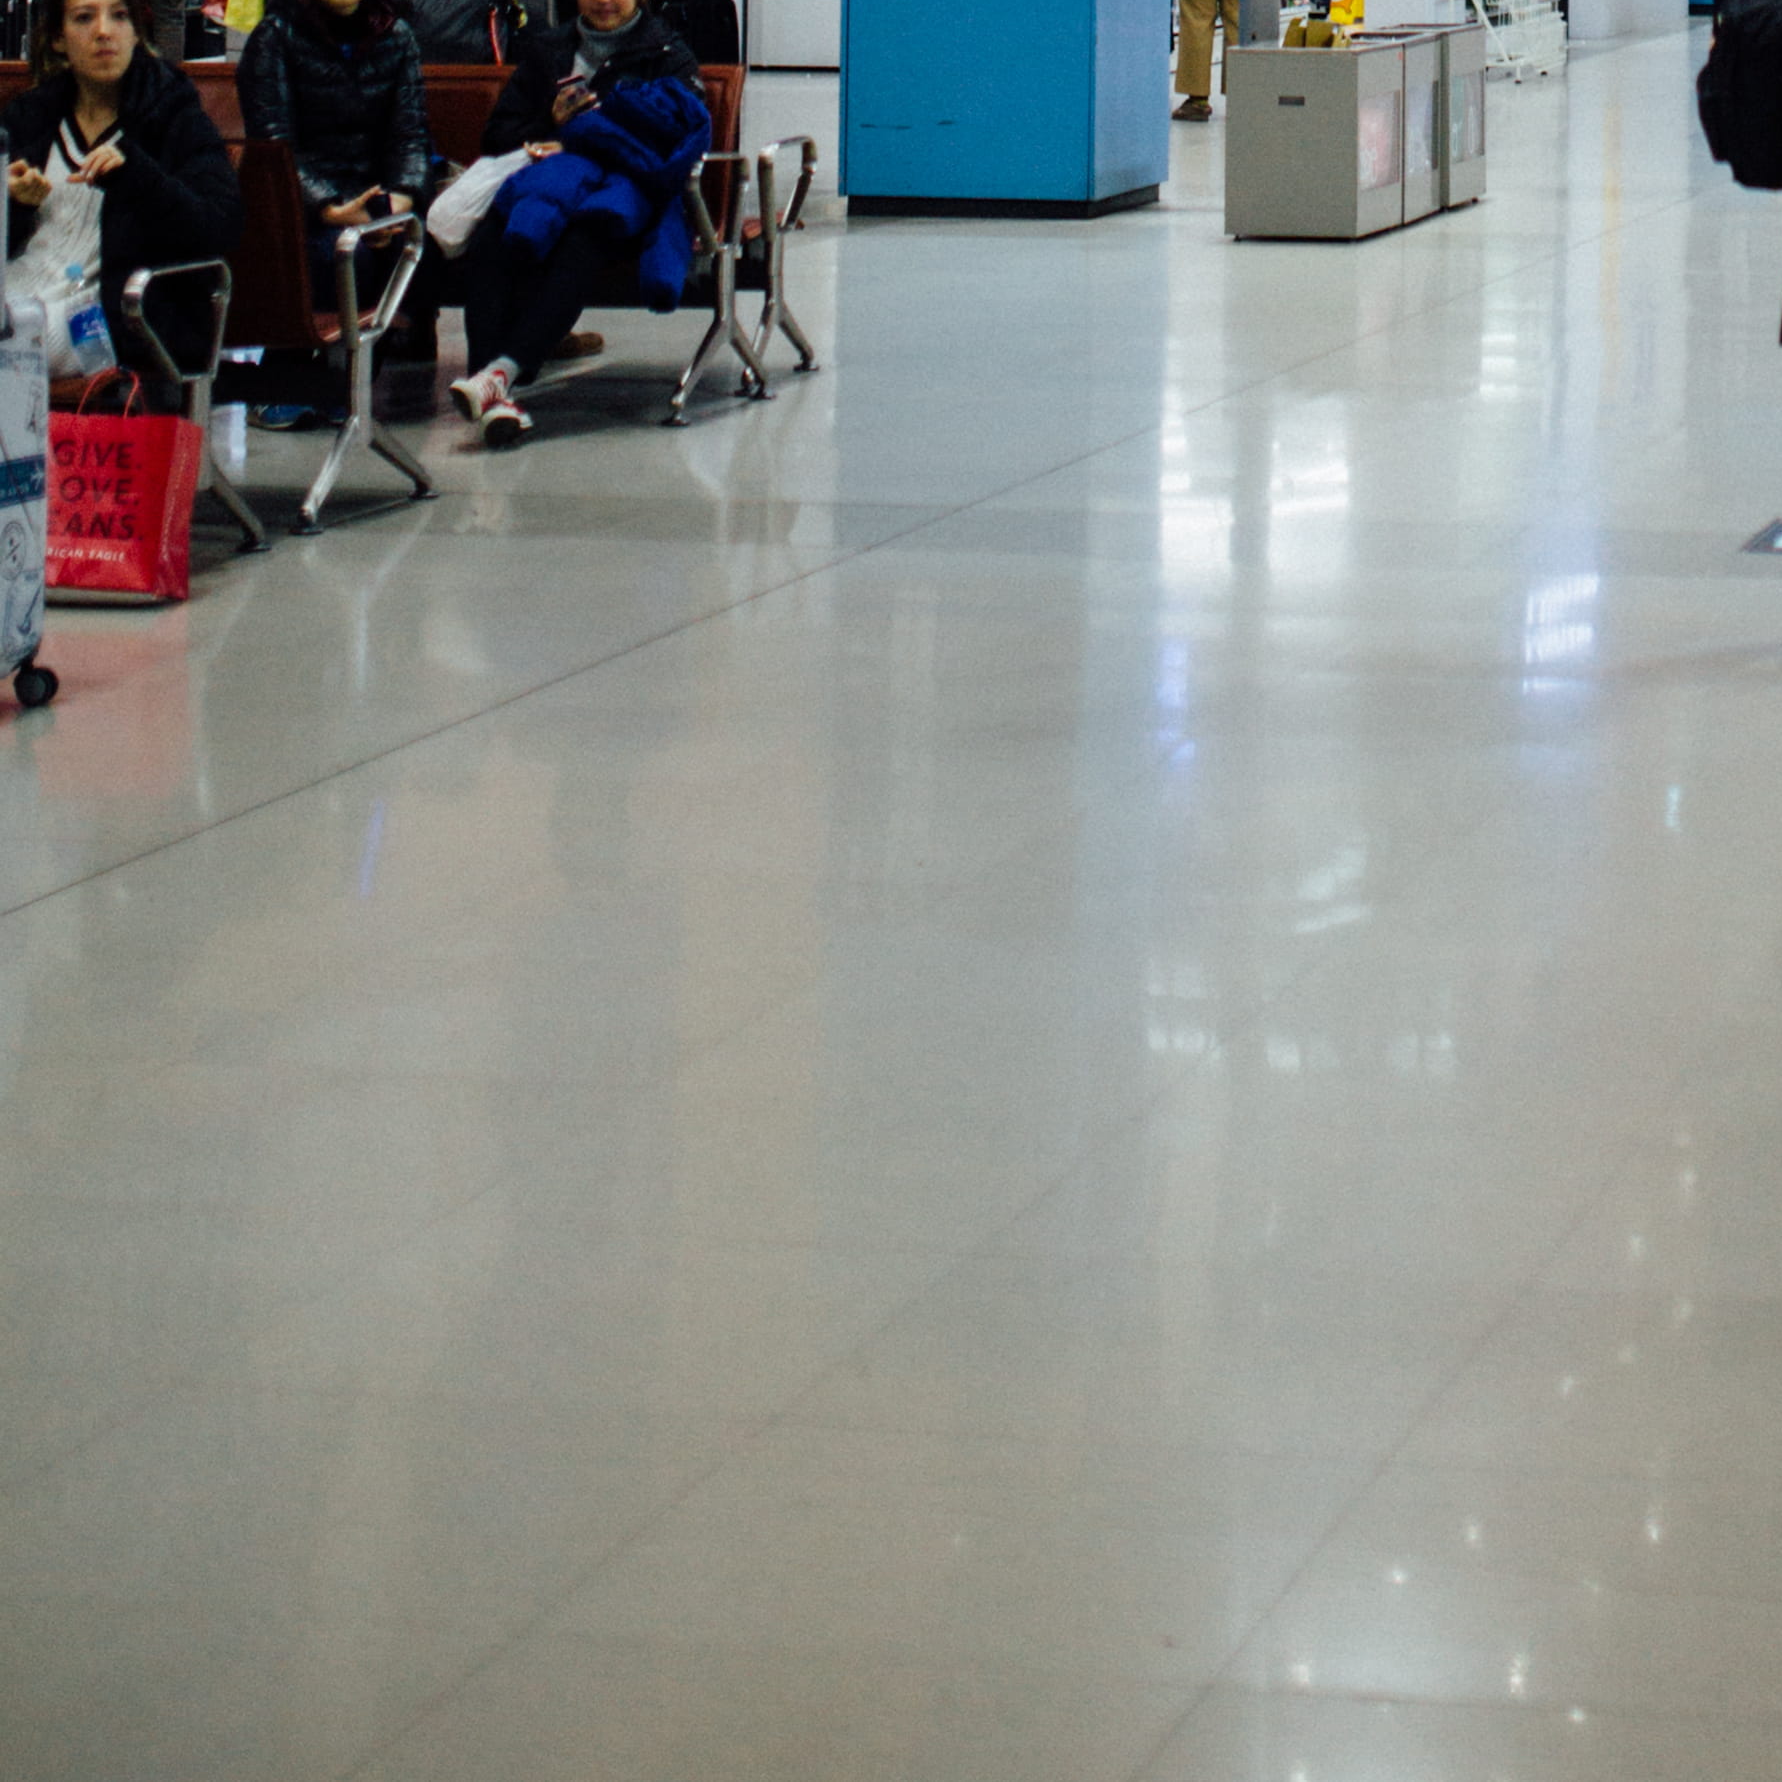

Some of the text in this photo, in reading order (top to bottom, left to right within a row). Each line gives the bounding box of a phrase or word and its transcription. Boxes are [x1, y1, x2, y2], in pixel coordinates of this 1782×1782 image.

[53, 439, 143, 470] GIVE.
[60, 475, 140, 506] OVE.
[88, 550, 126, 562] EAGLE
